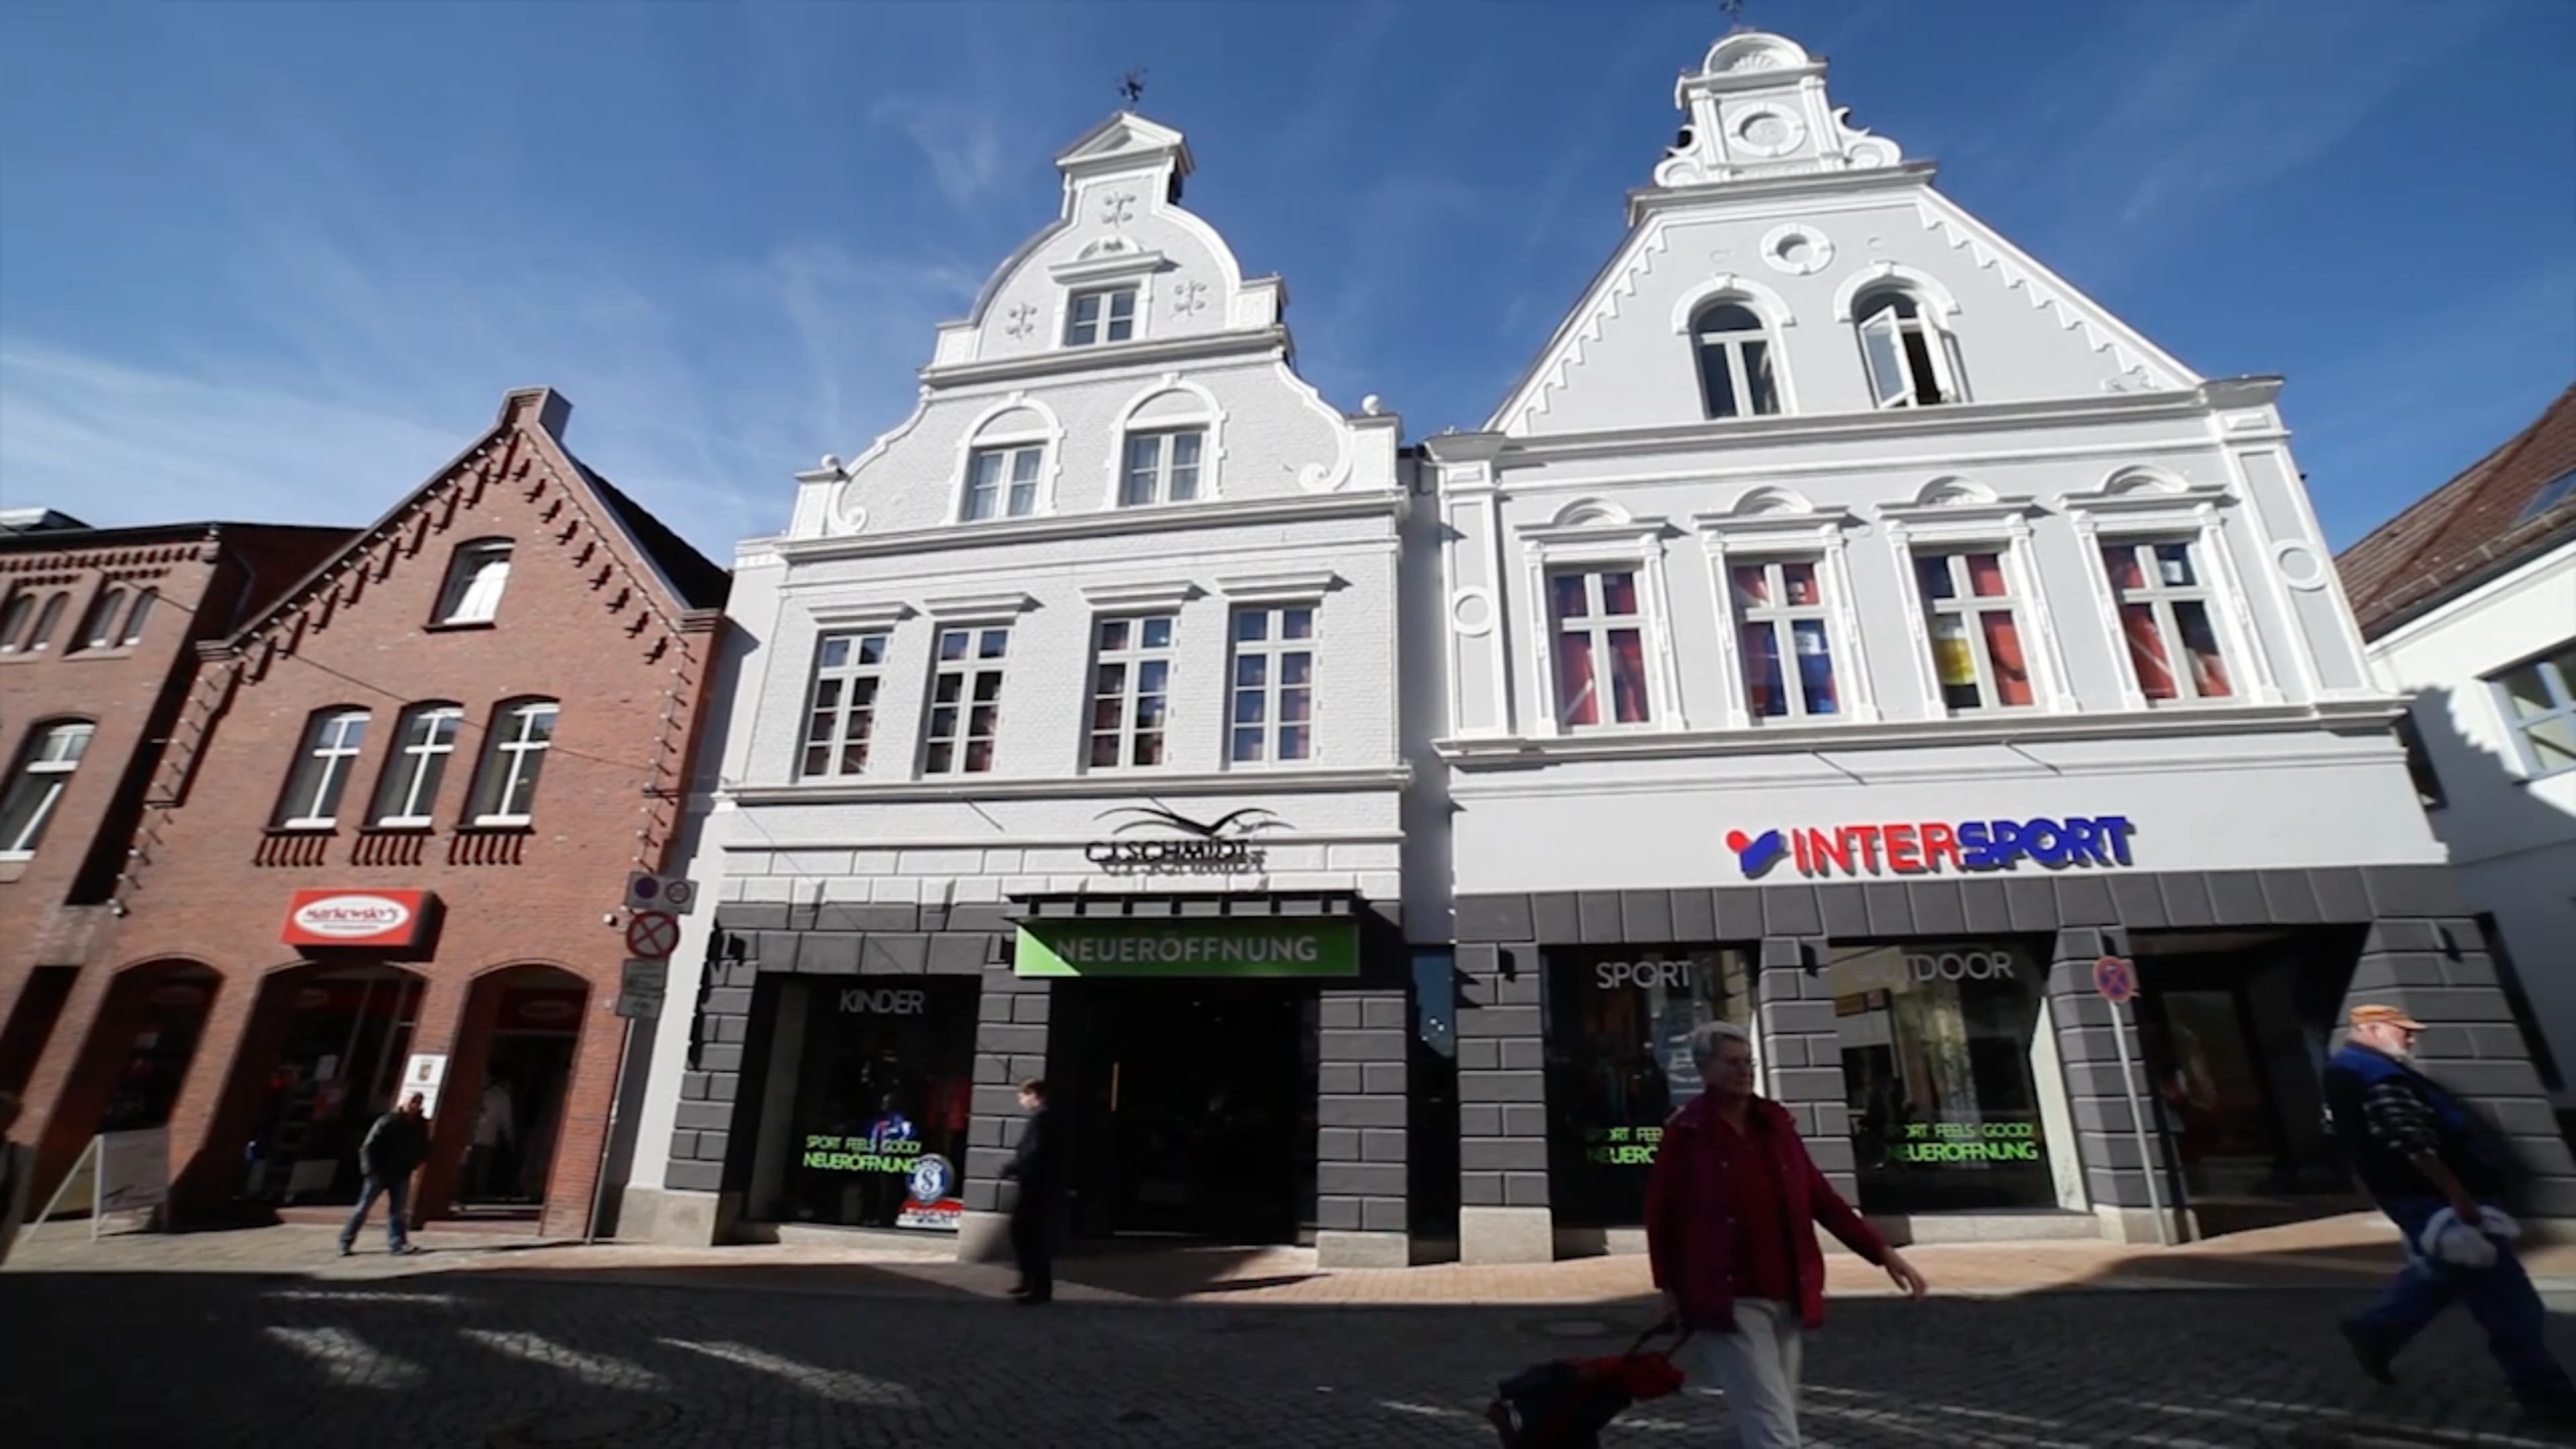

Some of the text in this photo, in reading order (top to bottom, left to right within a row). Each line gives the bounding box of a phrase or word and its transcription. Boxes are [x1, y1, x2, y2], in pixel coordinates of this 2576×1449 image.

[1792, 816, 2129, 872] INTERSPORT
[1056, 931, 1317, 962] NEUERÖFFNUNG
[1595, 961, 1693, 989] SPORT
[839, 989, 925, 1014] KINDER
